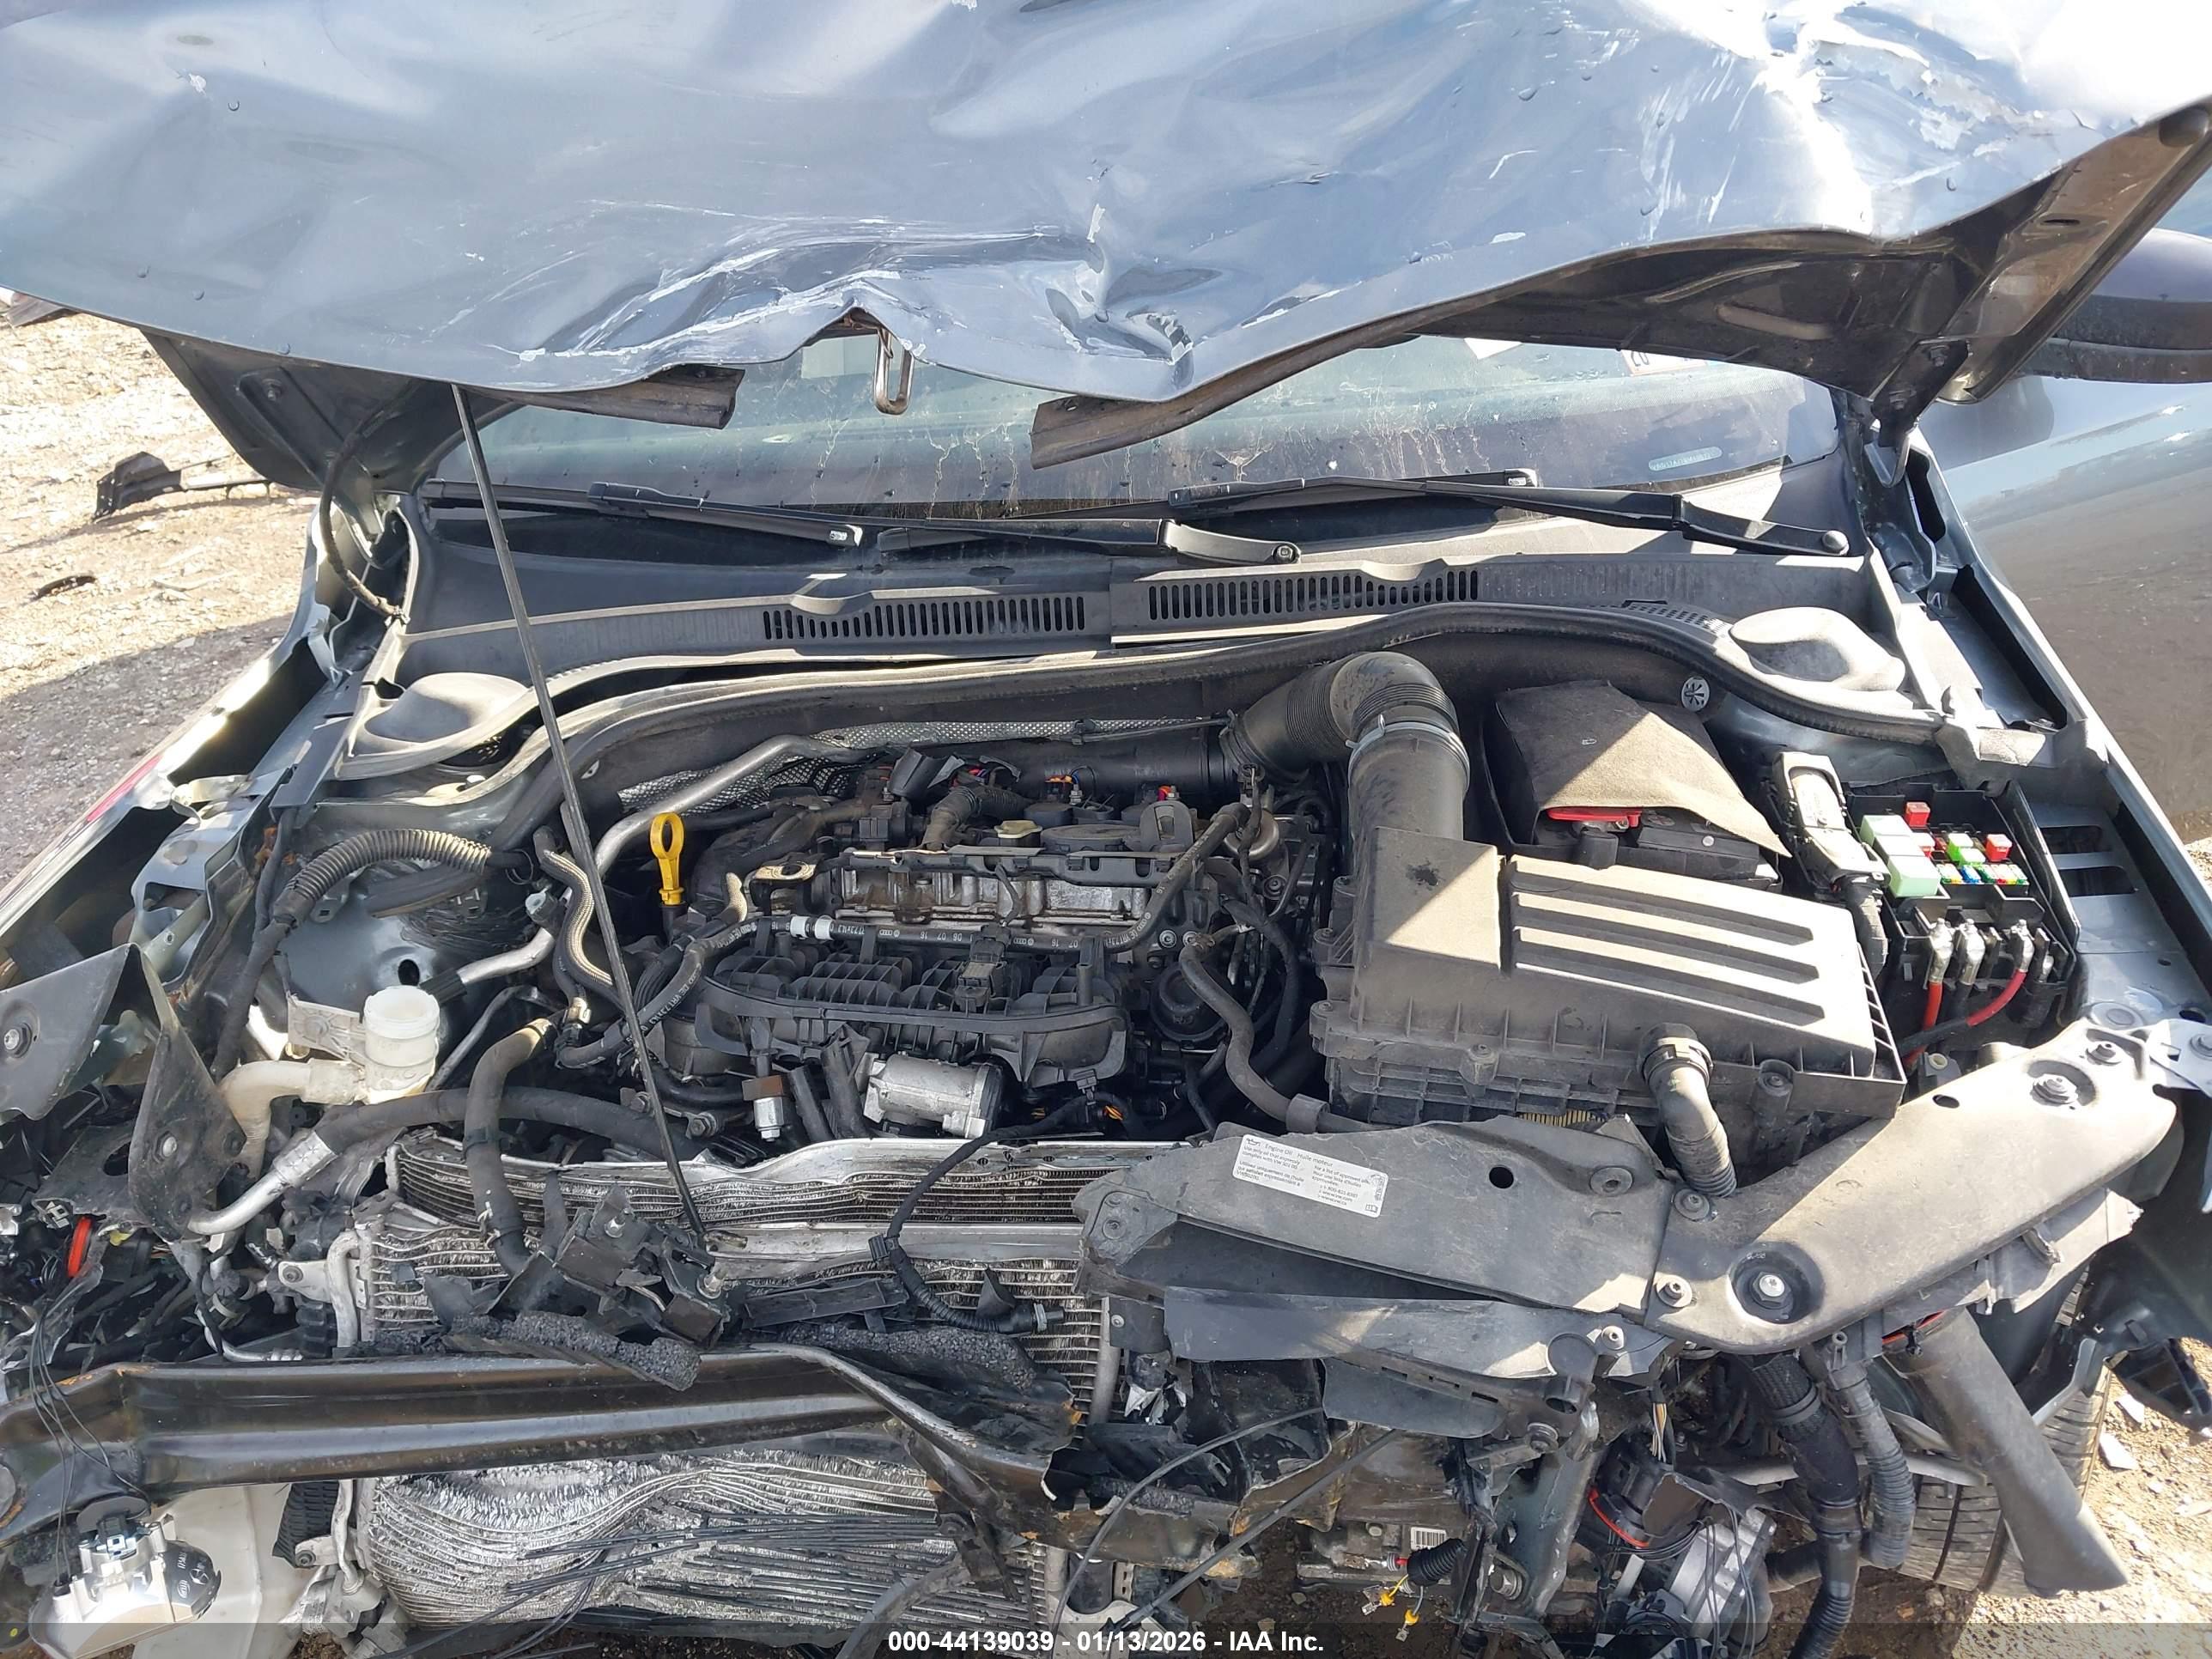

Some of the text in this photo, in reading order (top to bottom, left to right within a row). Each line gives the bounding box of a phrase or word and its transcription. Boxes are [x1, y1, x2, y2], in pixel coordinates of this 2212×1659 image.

[678, 983, 690, 996] DE
[1264, 1143, 1284, 1153] Engine
[1296, 1152, 1312, 1161] Huile
[1312, 1157, 1333, 1167] moteur
